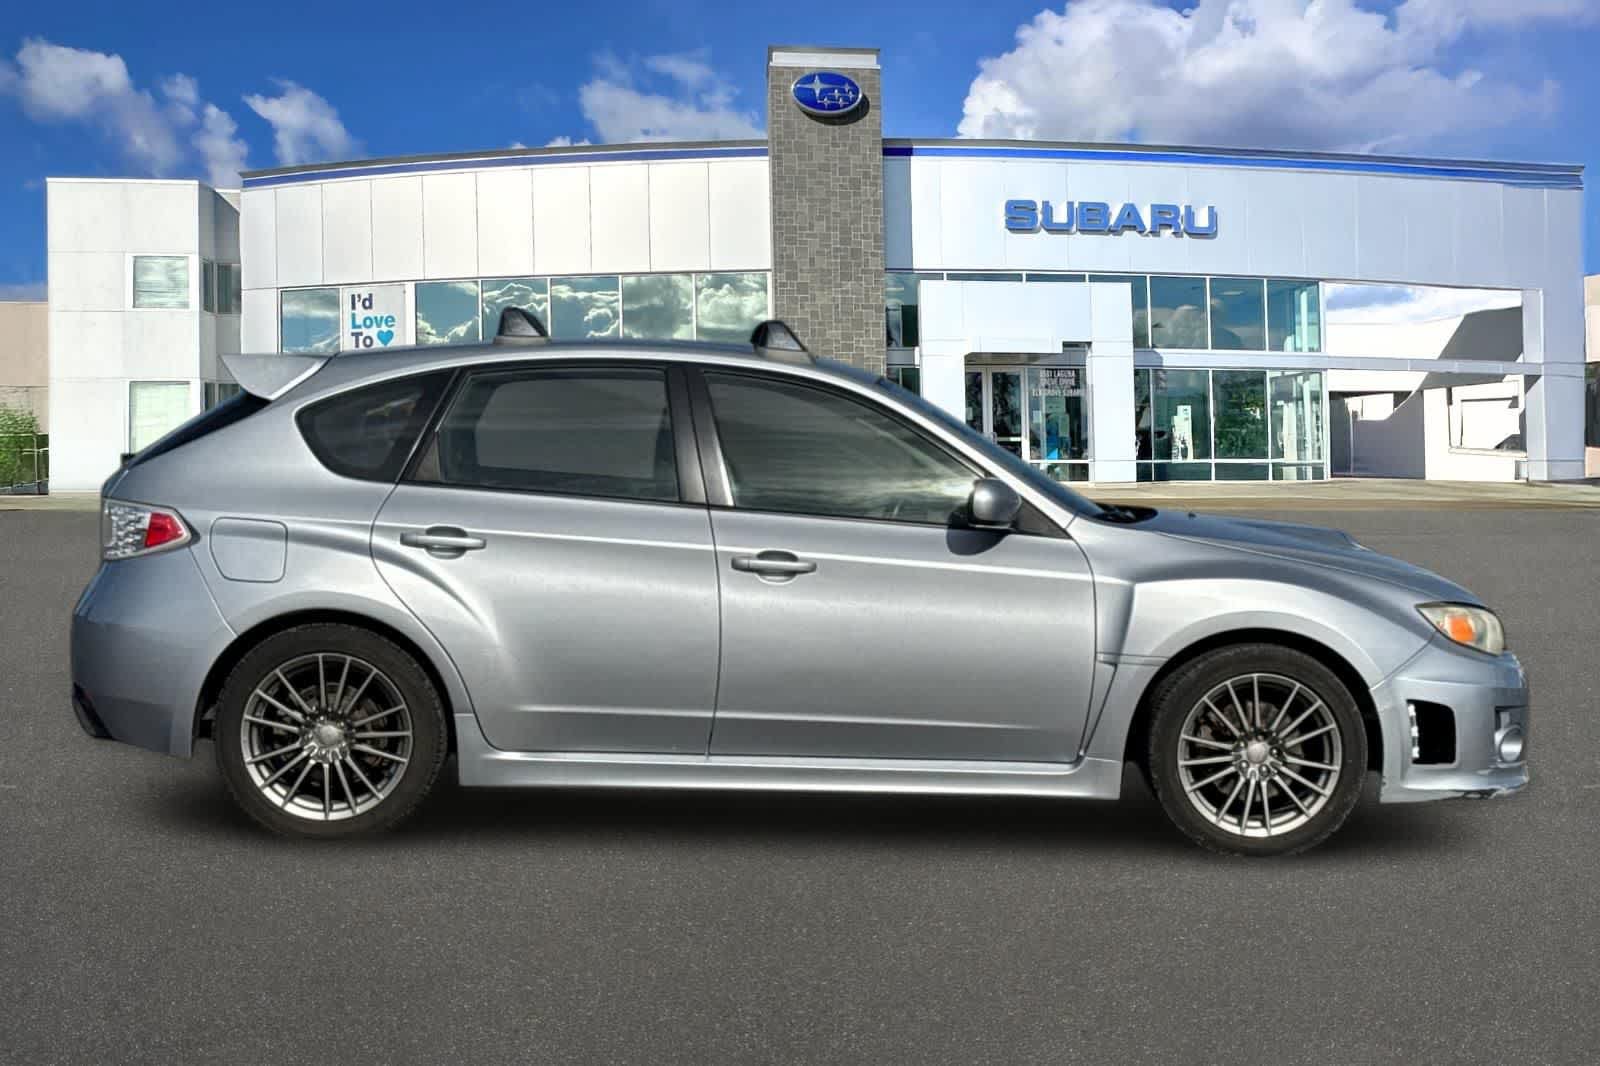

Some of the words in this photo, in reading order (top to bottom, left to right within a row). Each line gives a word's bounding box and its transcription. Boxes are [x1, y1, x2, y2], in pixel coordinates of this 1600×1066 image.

[1005, 200, 1217, 237] SUBARU
[351, 293, 373, 310] I'd
[351, 312, 396, 329] Love
[351, 331, 374, 348] To
